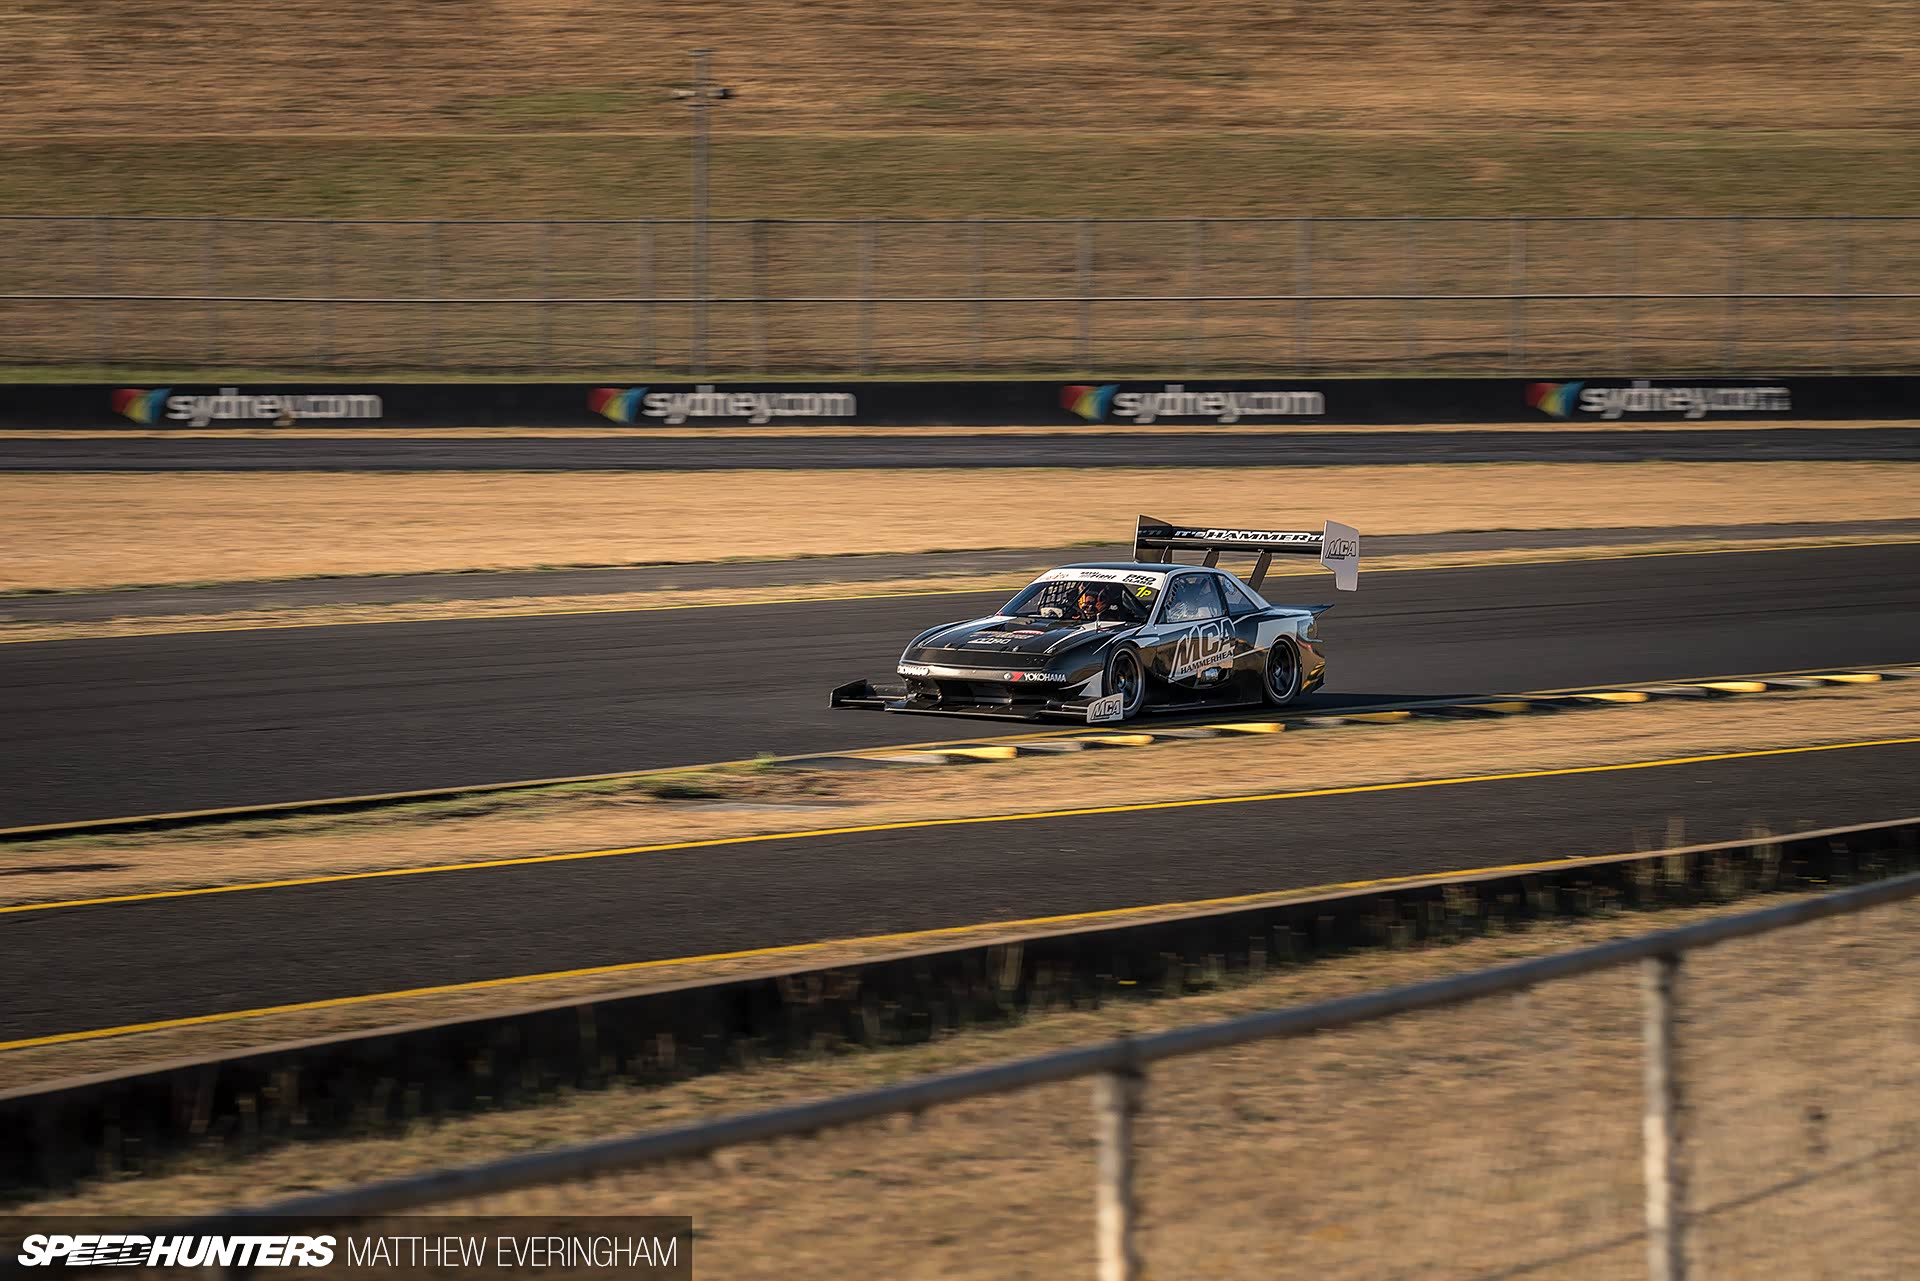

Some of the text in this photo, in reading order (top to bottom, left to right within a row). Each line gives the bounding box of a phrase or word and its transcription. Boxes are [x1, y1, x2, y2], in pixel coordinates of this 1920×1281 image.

[166, 387, 383, 426] sydney.com
[643, 385, 856, 423] sydney.com
[1113, 384, 1324, 422] sydney.com
[1579, 380, 1792, 419] sydney.com
[1325, 537, 1357, 559] MCA
[1125, 573, 1157, 585] PRO
[1168, 617, 1236, 683] MCA
[1024, 673, 1067, 682] YOKOHAMA
[1091, 699, 1121, 720] MCA
